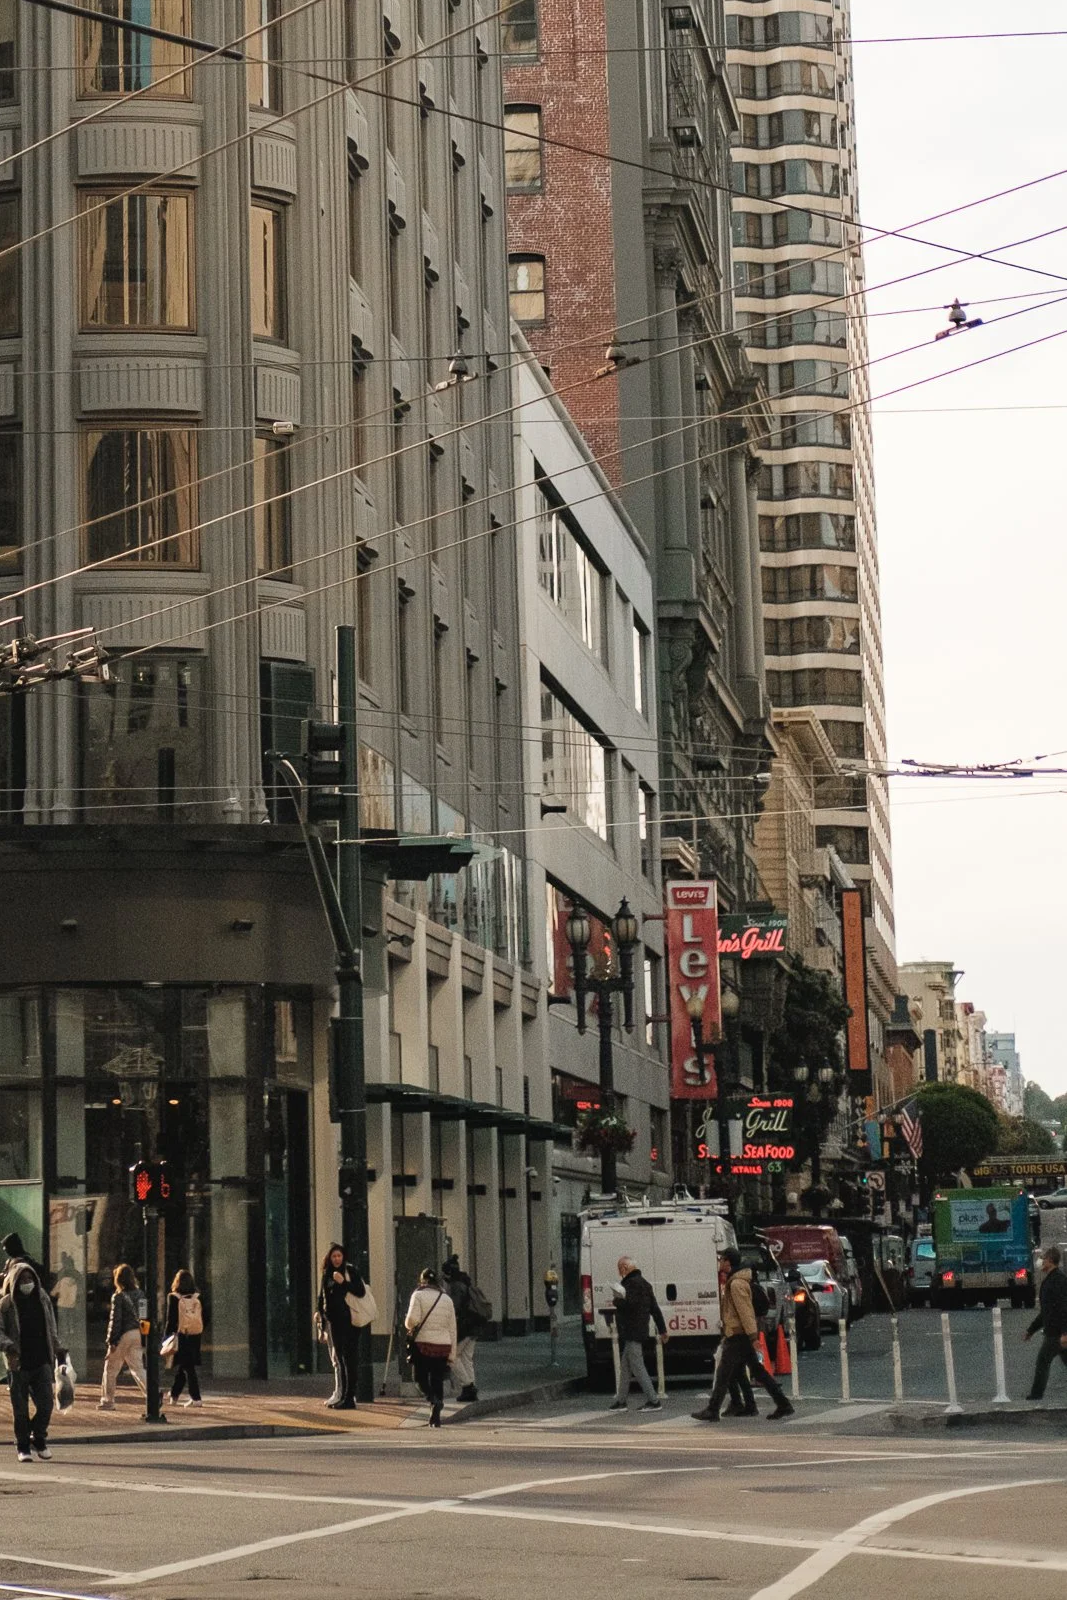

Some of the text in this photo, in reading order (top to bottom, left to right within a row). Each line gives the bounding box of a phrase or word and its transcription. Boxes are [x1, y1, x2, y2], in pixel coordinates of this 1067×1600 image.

[768, 919, 787, 927] 1908
[741, 927, 785, 960] Grill
[773, 1098, 794, 1108] 1908
[745, 1108, 788, 1138] Grill
[716, 1165, 763, 1175] CKTAILS
[767, 1161, 783, 1173] 63
[1011, 1164, 1043, 1174] TOURS
[1045, 1163, 1066, 1173] USA
[958, 1212, 979, 1223] plus
[668, 1314, 708, 1331] dish
